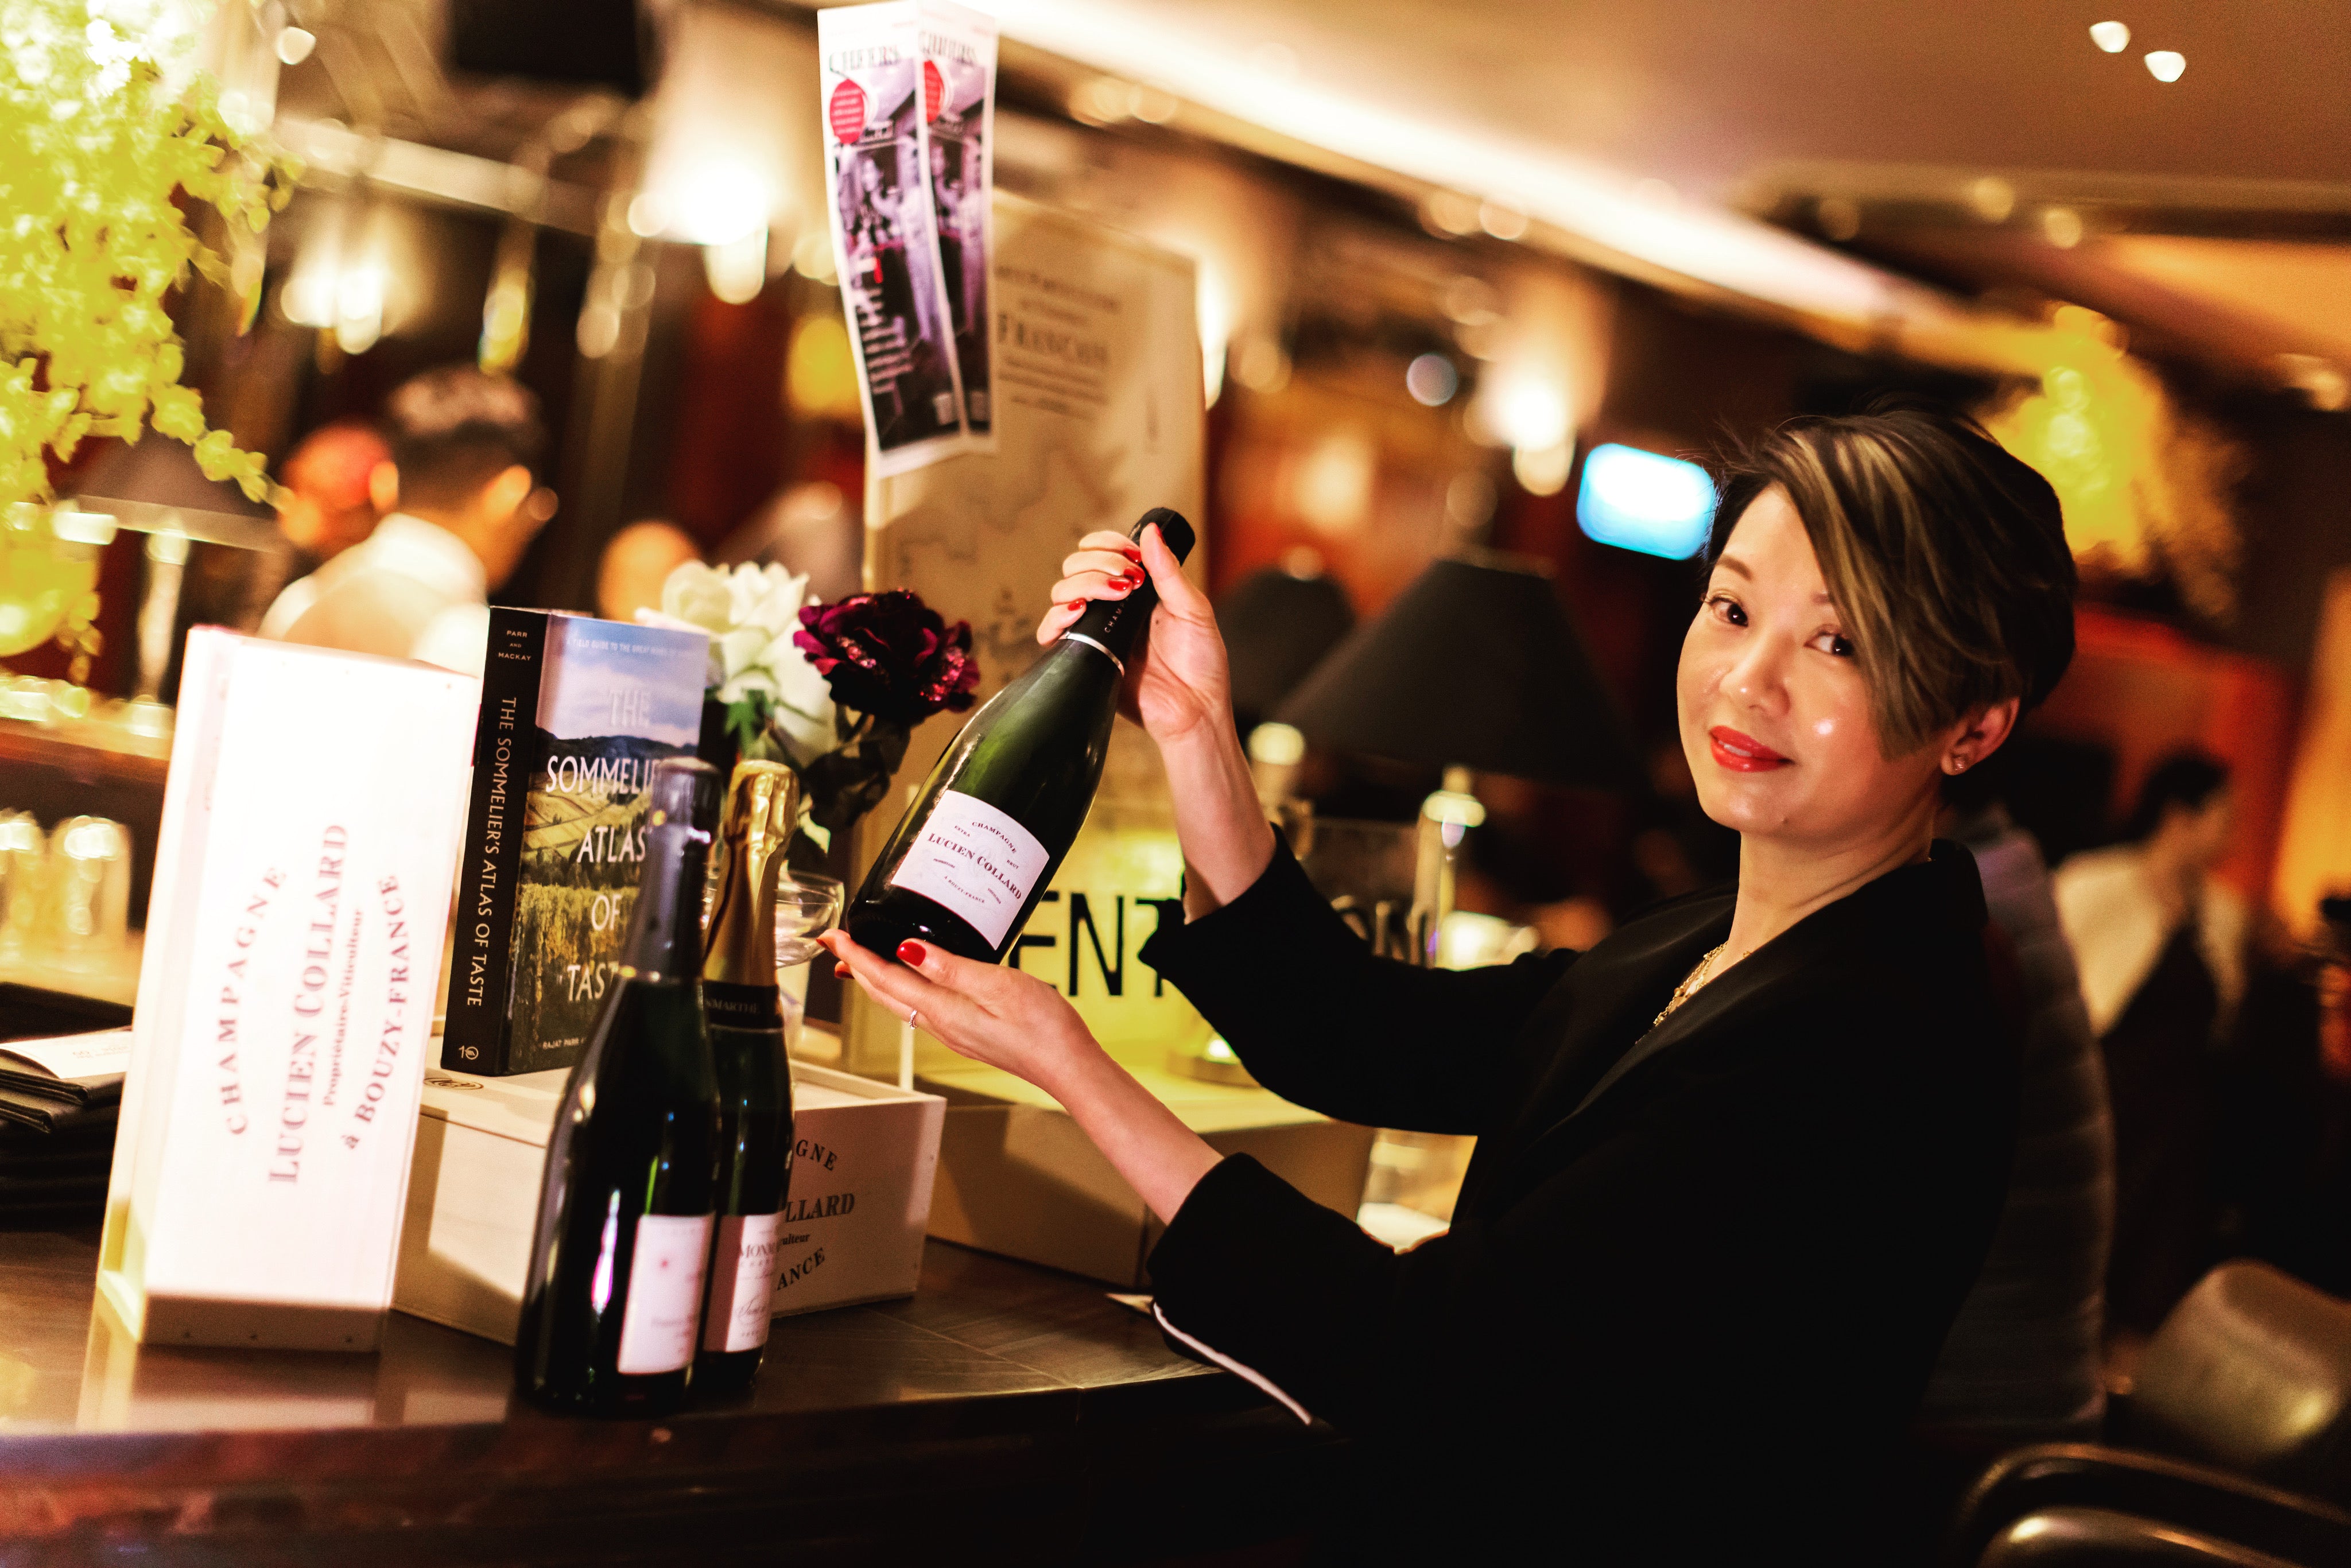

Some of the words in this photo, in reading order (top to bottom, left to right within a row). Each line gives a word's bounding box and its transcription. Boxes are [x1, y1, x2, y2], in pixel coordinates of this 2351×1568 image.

[506, 630, 527, 639] PARR
[498, 652, 532, 661] MACKAY
[499, 697, 516, 731] THE
[611, 689, 650, 728] THE
[485, 738, 511, 854] SOMMELIER'S
[577, 826, 647, 863] ATLAS
[954, 825, 971, 837] EXTRA
[1007, 859, 1019, 869] BRUT
[972, 821, 1017, 854] CHAMPAGNE
[928, 833, 975, 860] LUCIEN
[977, 856, 1022, 899] COLLARD
[478, 859, 497, 917] ATLAS
[591, 894, 622, 932] OF
[474, 923, 490, 948] OF
[355, 875, 409, 1123] BOUZY-FRANCE
[467, 954, 487, 1006] TASTE
[218, 867, 286, 1136] CHAMPAGNE
[270, 1033, 318, 1183] LUCIEN
[294, 825, 348, 1019] COLLARD
